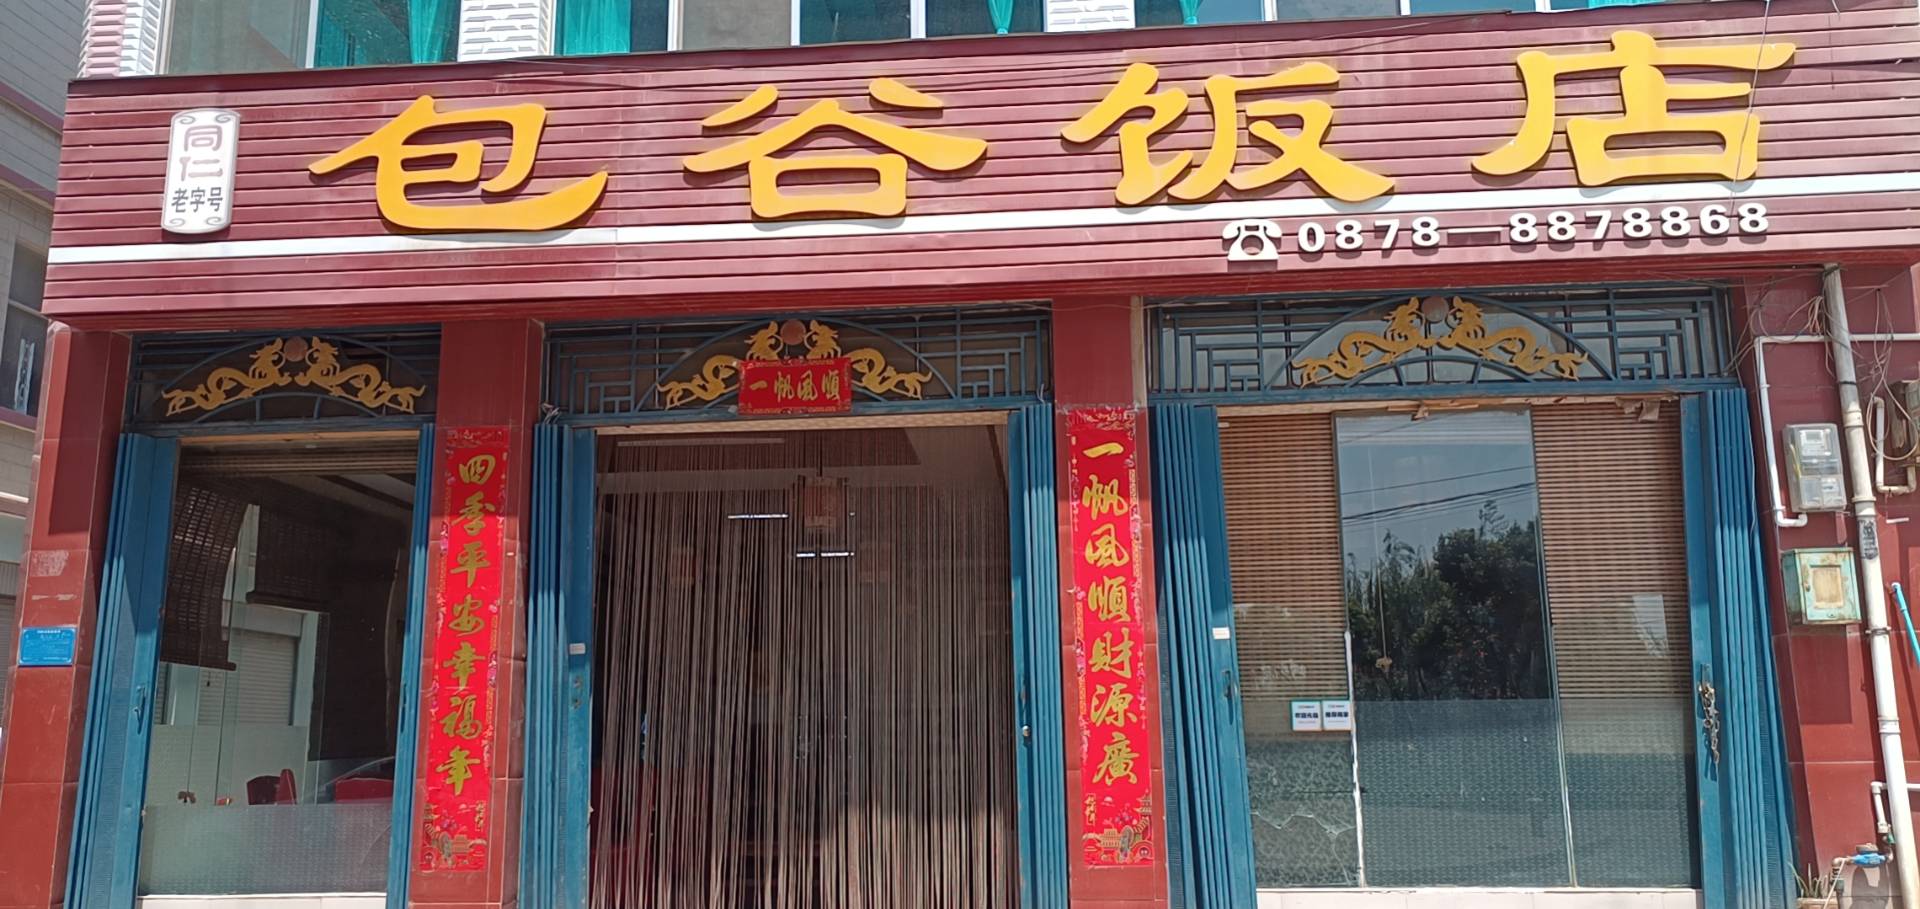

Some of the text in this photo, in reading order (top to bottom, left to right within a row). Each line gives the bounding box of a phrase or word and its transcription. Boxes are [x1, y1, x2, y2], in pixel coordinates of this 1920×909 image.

[180, 125, 223, 181] 同仁
[309, 30, 1796, 231] 包谷饭店
[171, 186, 223, 213] 老字号
[436, 455, 496, 796] 四季平安幸福年
